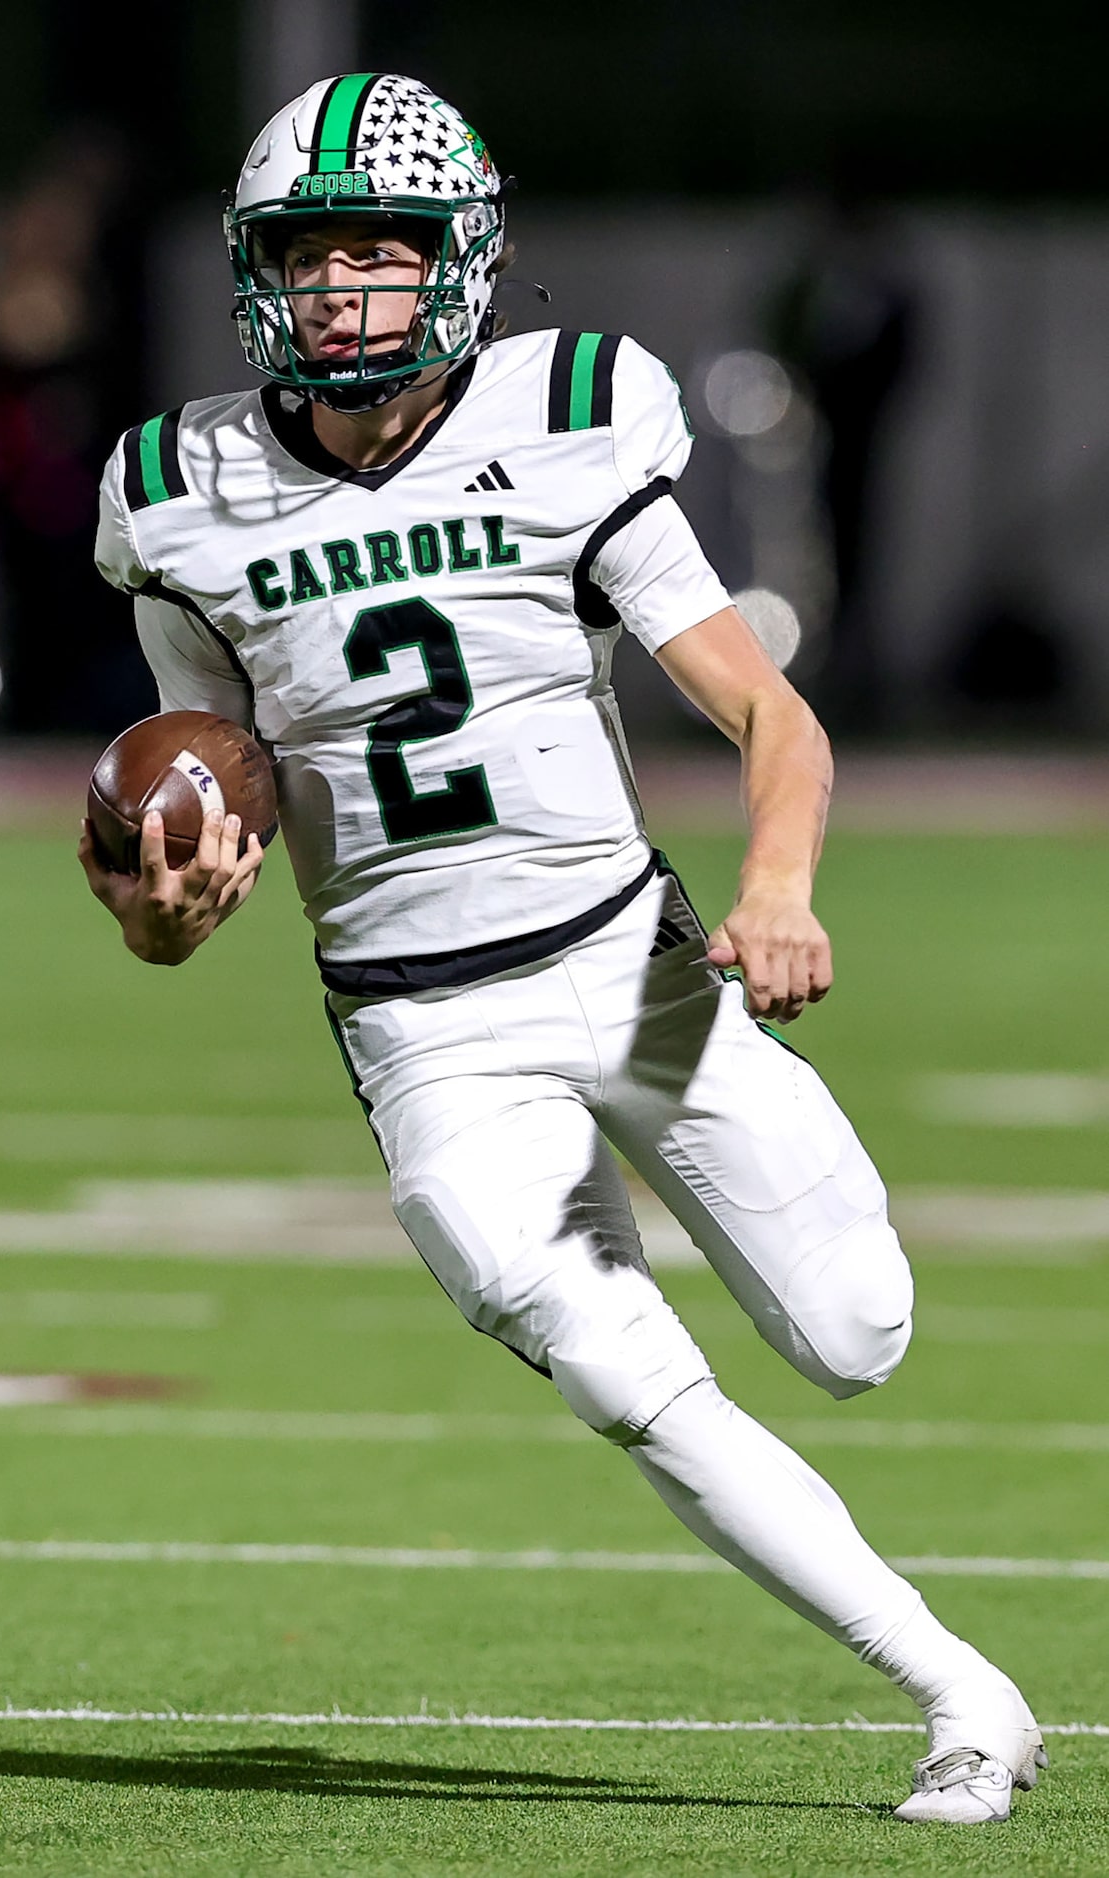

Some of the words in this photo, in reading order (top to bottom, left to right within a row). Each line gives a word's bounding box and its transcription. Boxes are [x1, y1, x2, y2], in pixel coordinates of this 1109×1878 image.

[297, 172, 369, 196] 76092
[245, 515, 522, 612] CARROLL
[342, 595, 499, 846] 2
